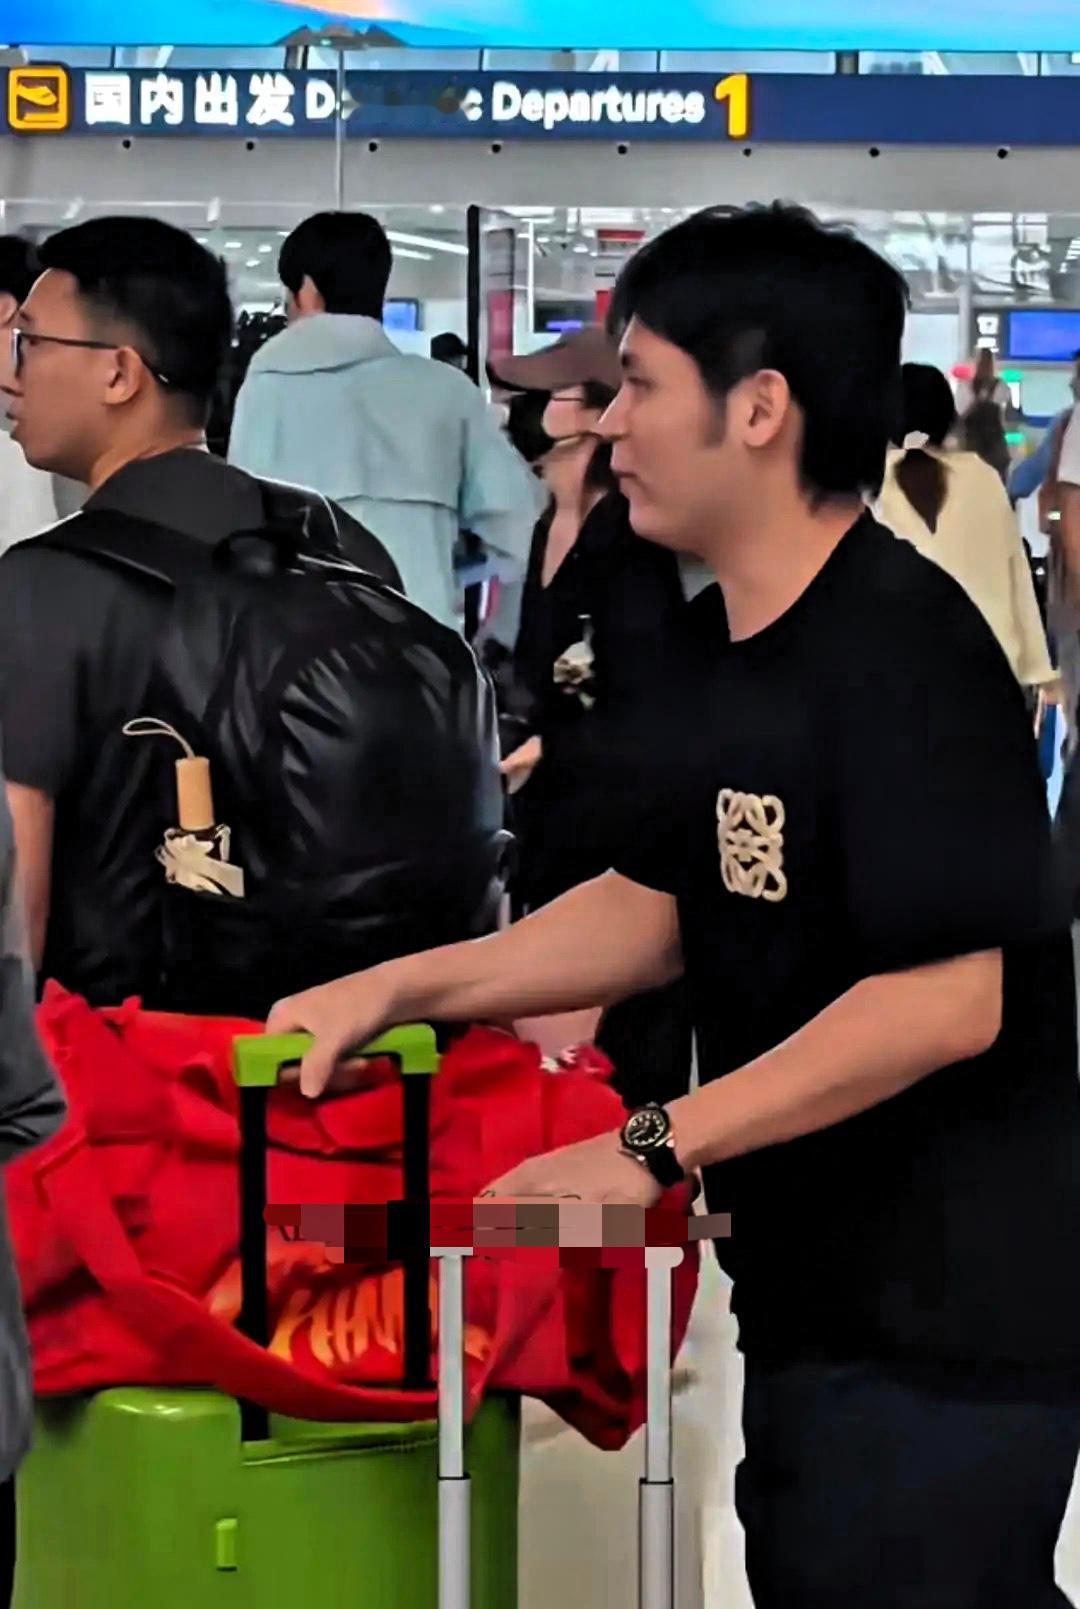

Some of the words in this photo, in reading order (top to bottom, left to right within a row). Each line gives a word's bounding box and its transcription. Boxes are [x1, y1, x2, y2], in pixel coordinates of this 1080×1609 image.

[85, 72, 295, 126] 国内出发
[491, 80, 706, 130] Departures
[714, 72, 749, 136] 1
